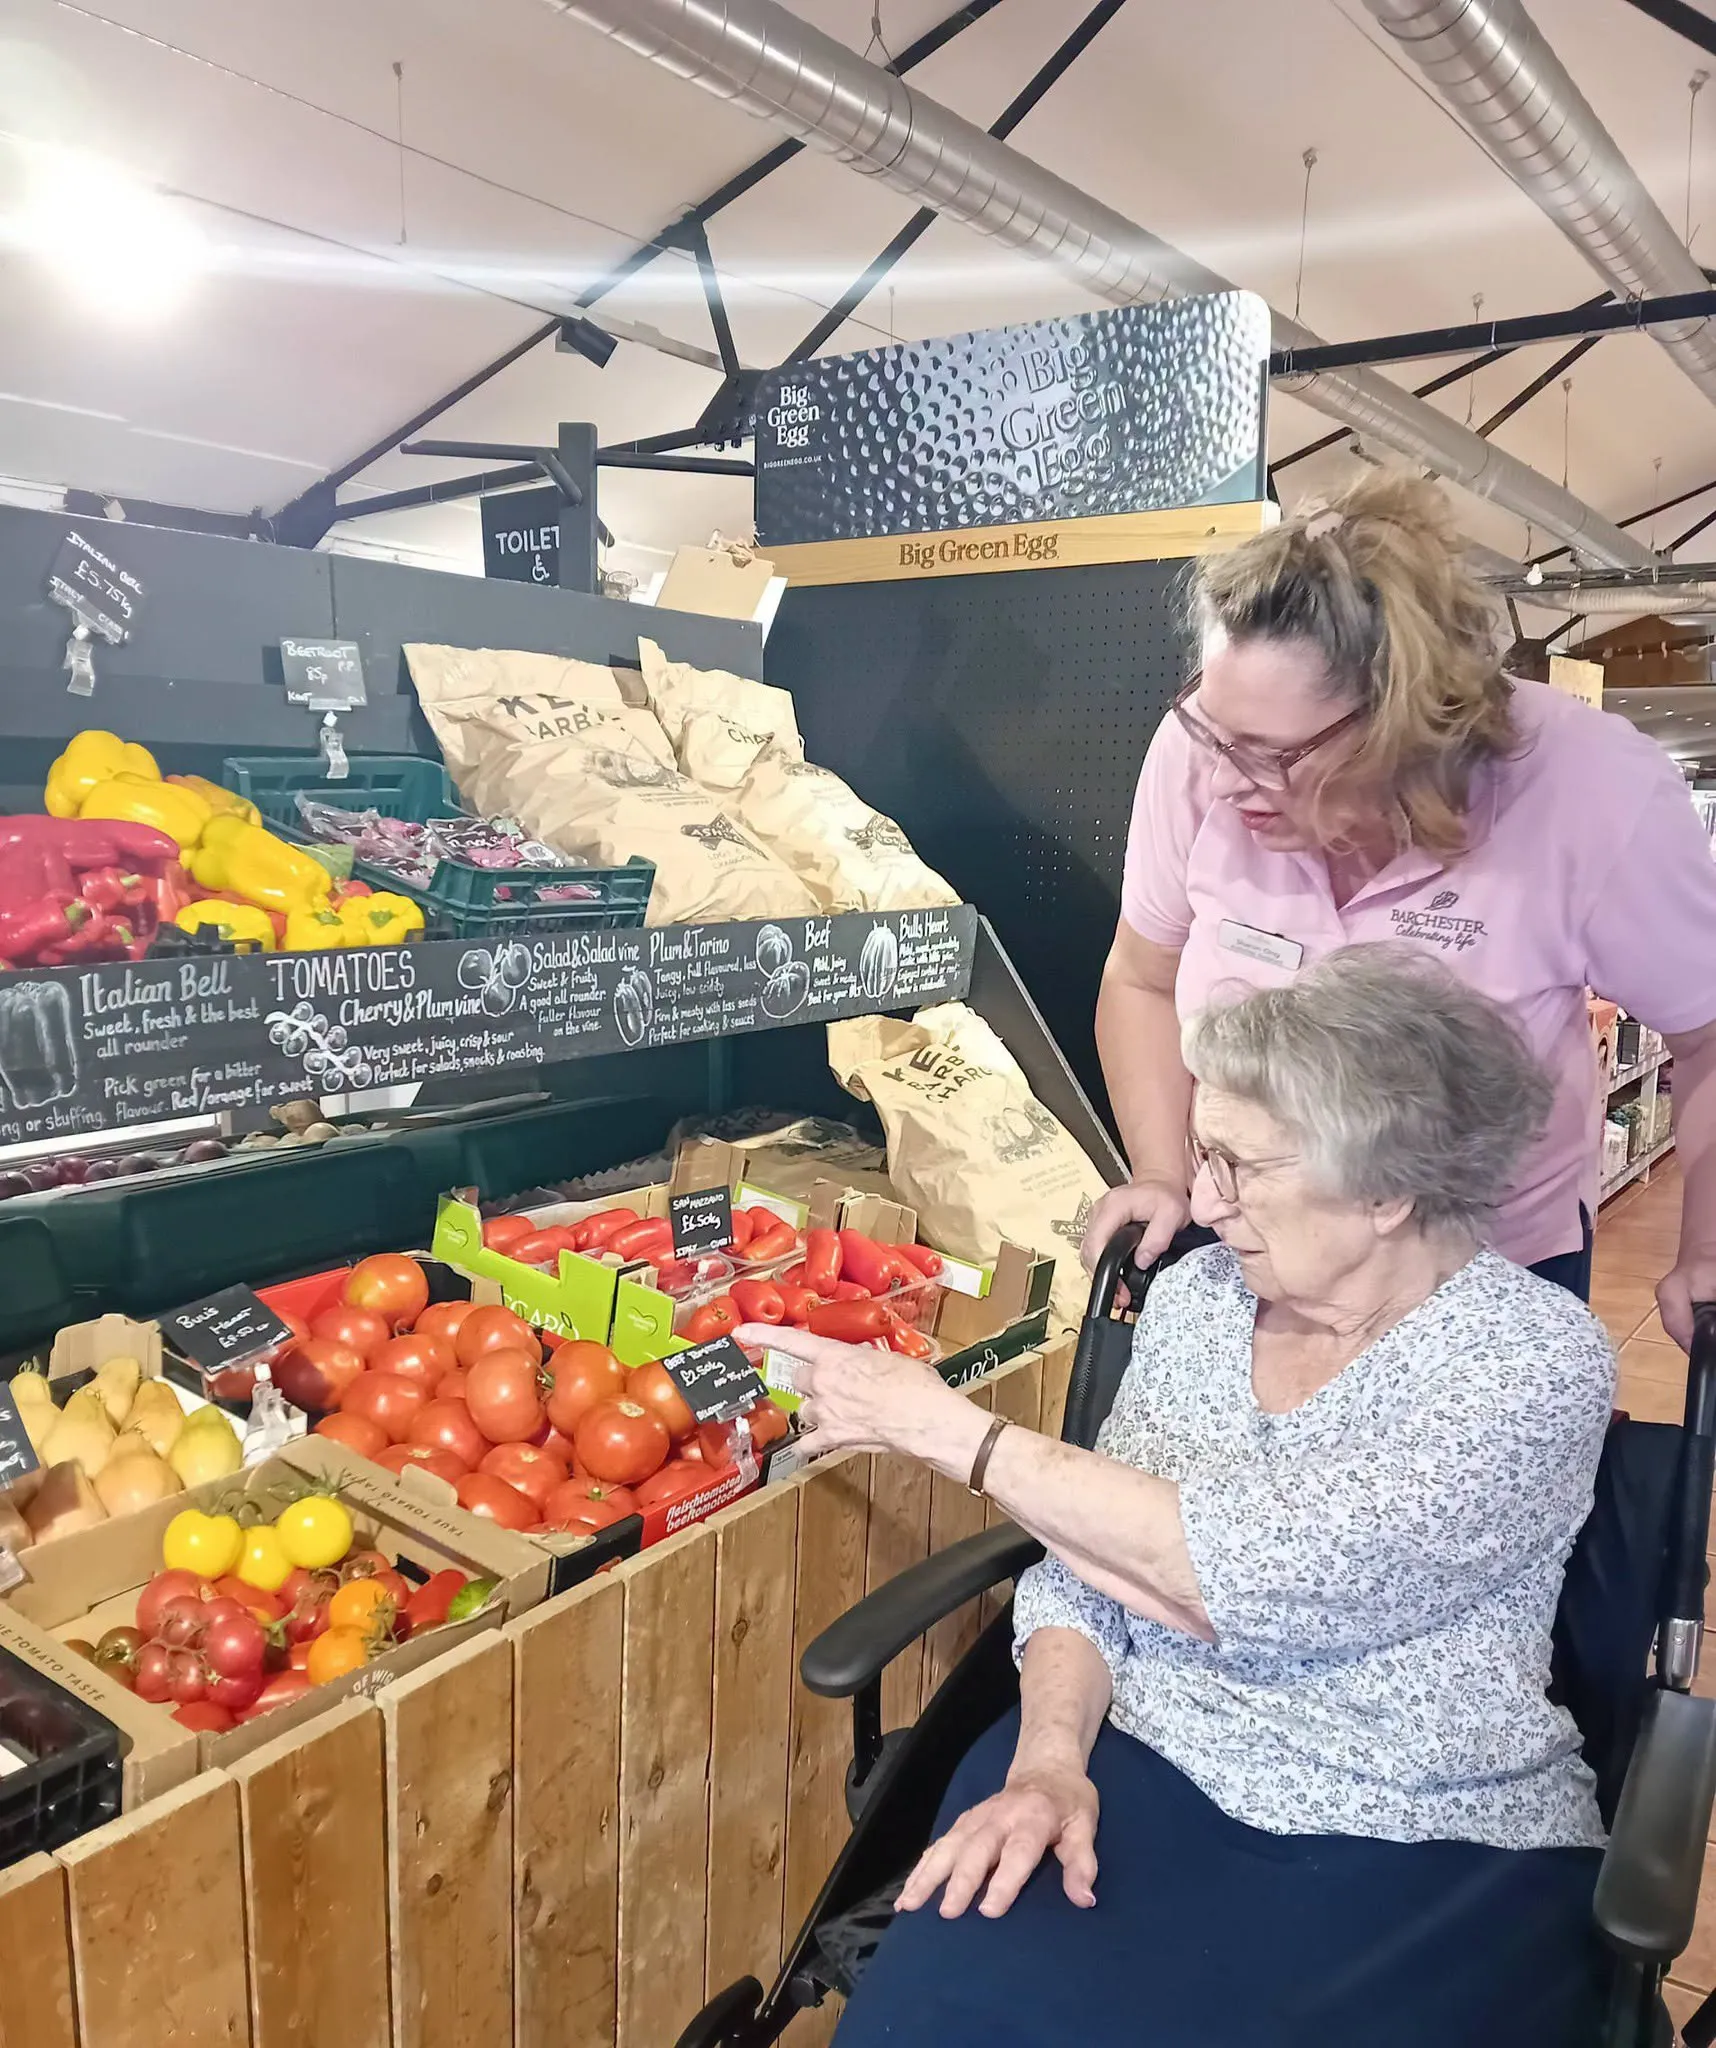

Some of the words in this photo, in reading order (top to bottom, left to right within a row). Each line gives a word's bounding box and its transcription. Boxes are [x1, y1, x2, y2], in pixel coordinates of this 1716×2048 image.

[1021, 336, 1097, 393] Big
[780, 385, 808, 408] Big
[767, 405, 820, 427] Green
[1001, 381, 1127, 452] Green
[776, 425, 809, 448] Egg
[1032, 424, 1115, 496] Egg
[66, 531, 117, 573] ITALIAN
[899, 543, 935, 569] Big
[939, 539, 1009, 563] Green
[1013, 533, 1059, 561] Egg
[282, 640, 356, 658] BEETROOT
[805, 919, 832, 952] Beef
[899, 913, 923, 942] Bulls
[925, 911, 950, 937] Heart
[1390, 909, 1488, 936] BARCHESTER
[1395, 924, 1453, 949] Celebrating
[1455, 932, 1476, 951] life
[618, 943, 640, 961] vine
[266, 951, 416, 1001] TOMATOES
[528, 973, 558, 991] Sweet
[560, 972, 568, 987] &
[571, 966, 597, 990] fruity
[688, 962, 702, 980] full
[744, 955, 757, 970] less
[79, 969, 172, 1018] Italian
[179, 960, 232, 1001] Bell
[519, 995, 527, 1010] A
[530, 990, 551, 1015] good
[555, 988, 568, 1004] all
[683, 983, 696, 995] low
[142, 1007, 181, 1034] fresh
[185, 1005, 197, 1024] &
[201, 1002, 225, 1024] the
[228, 998, 260, 1022] best
[455, 995, 481, 1017] vine
[539, 1009, 565, 1033] fuller
[569, 1005, 601, 1019] flavour
[672, 1006, 679, 1020] &
[553, 1027, 563, 1037] on
[566, 1021, 579, 1035] the
[648, 1024, 676, 1046] Perfect
[680, 1022, 691, 1039] for
[692, 1018, 719, 1036] cooking
[722, 1014, 728, 1030] &
[97, 1039, 119, 1059] all
[125, 1033, 188, 1055] rounder
[362, 1046, 390, 1065] Very
[104, 1075, 139, 1098] Pick
[144, 1074, 187, 1097] green
[191, 1067, 211, 1089] for
[214, 1070, 223, 1080] a
[225, 1061, 262, 1079] bitter
[374, 1060, 410, 1084] Perfect
[412, 1058, 428, 1079] for
[496, 1049, 504, 1065] &
[254, 1079, 275, 1104] for
[278, 1075, 314, 1096] sweet
[26, 1119, 41, 1132] or
[12, 1636, 64, 1672] TOMATO
[65, 1673, 105, 1701] TASTE
